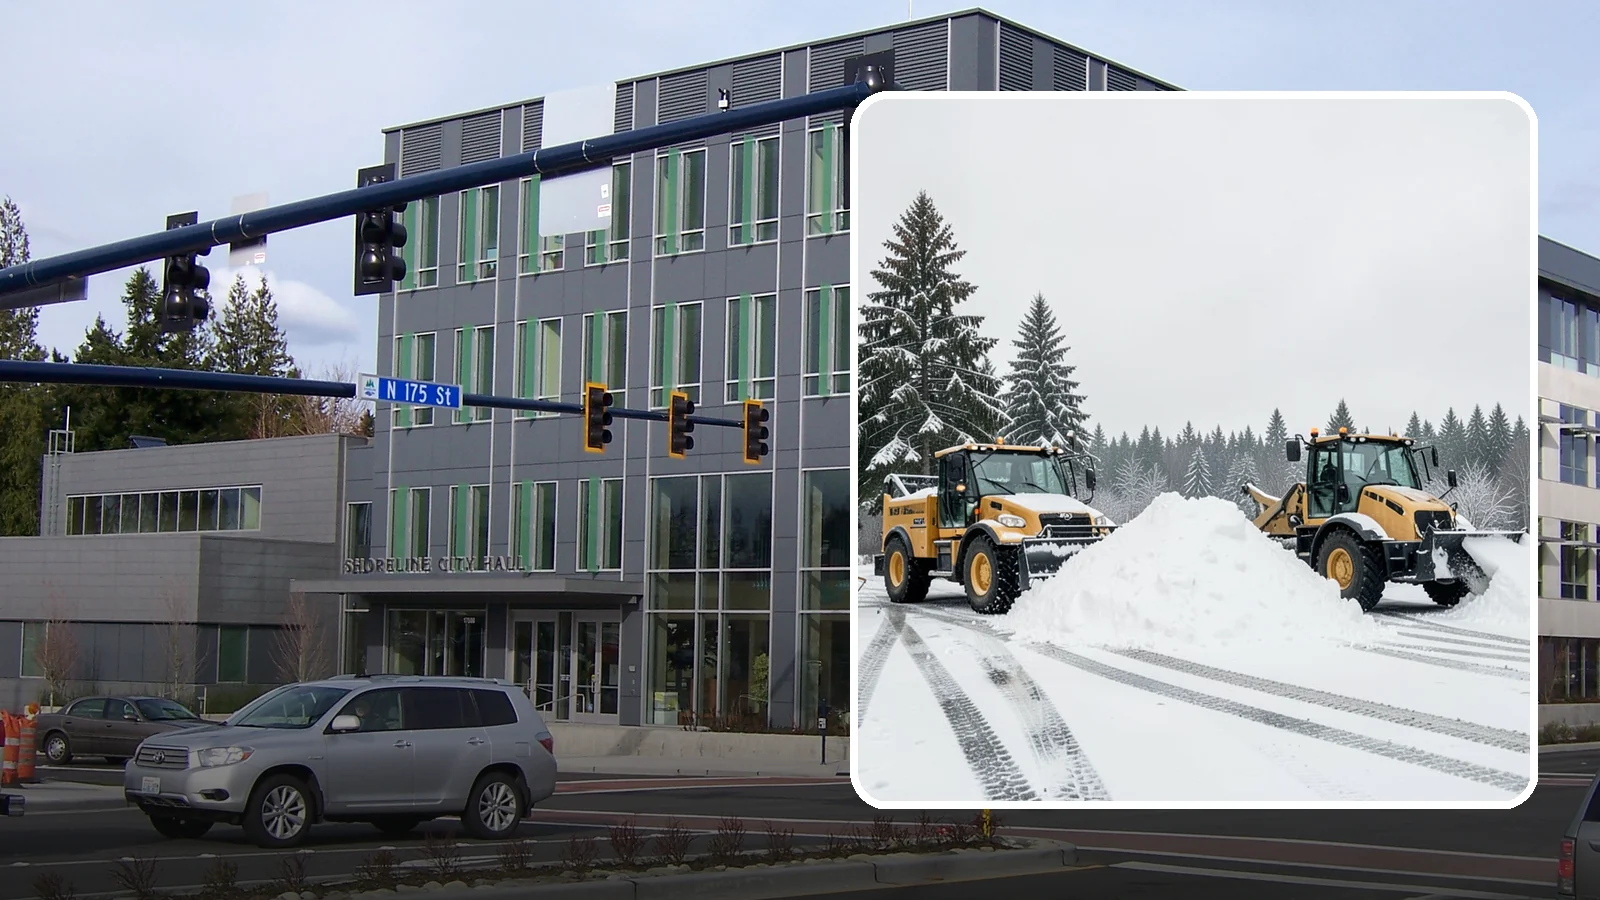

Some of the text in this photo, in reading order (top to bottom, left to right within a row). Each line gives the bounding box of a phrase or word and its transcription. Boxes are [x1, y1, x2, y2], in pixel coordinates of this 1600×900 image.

[387, 380, 452, 406] N 175 St
[343, 555, 526, 574] SHORELINE CITY HALL
